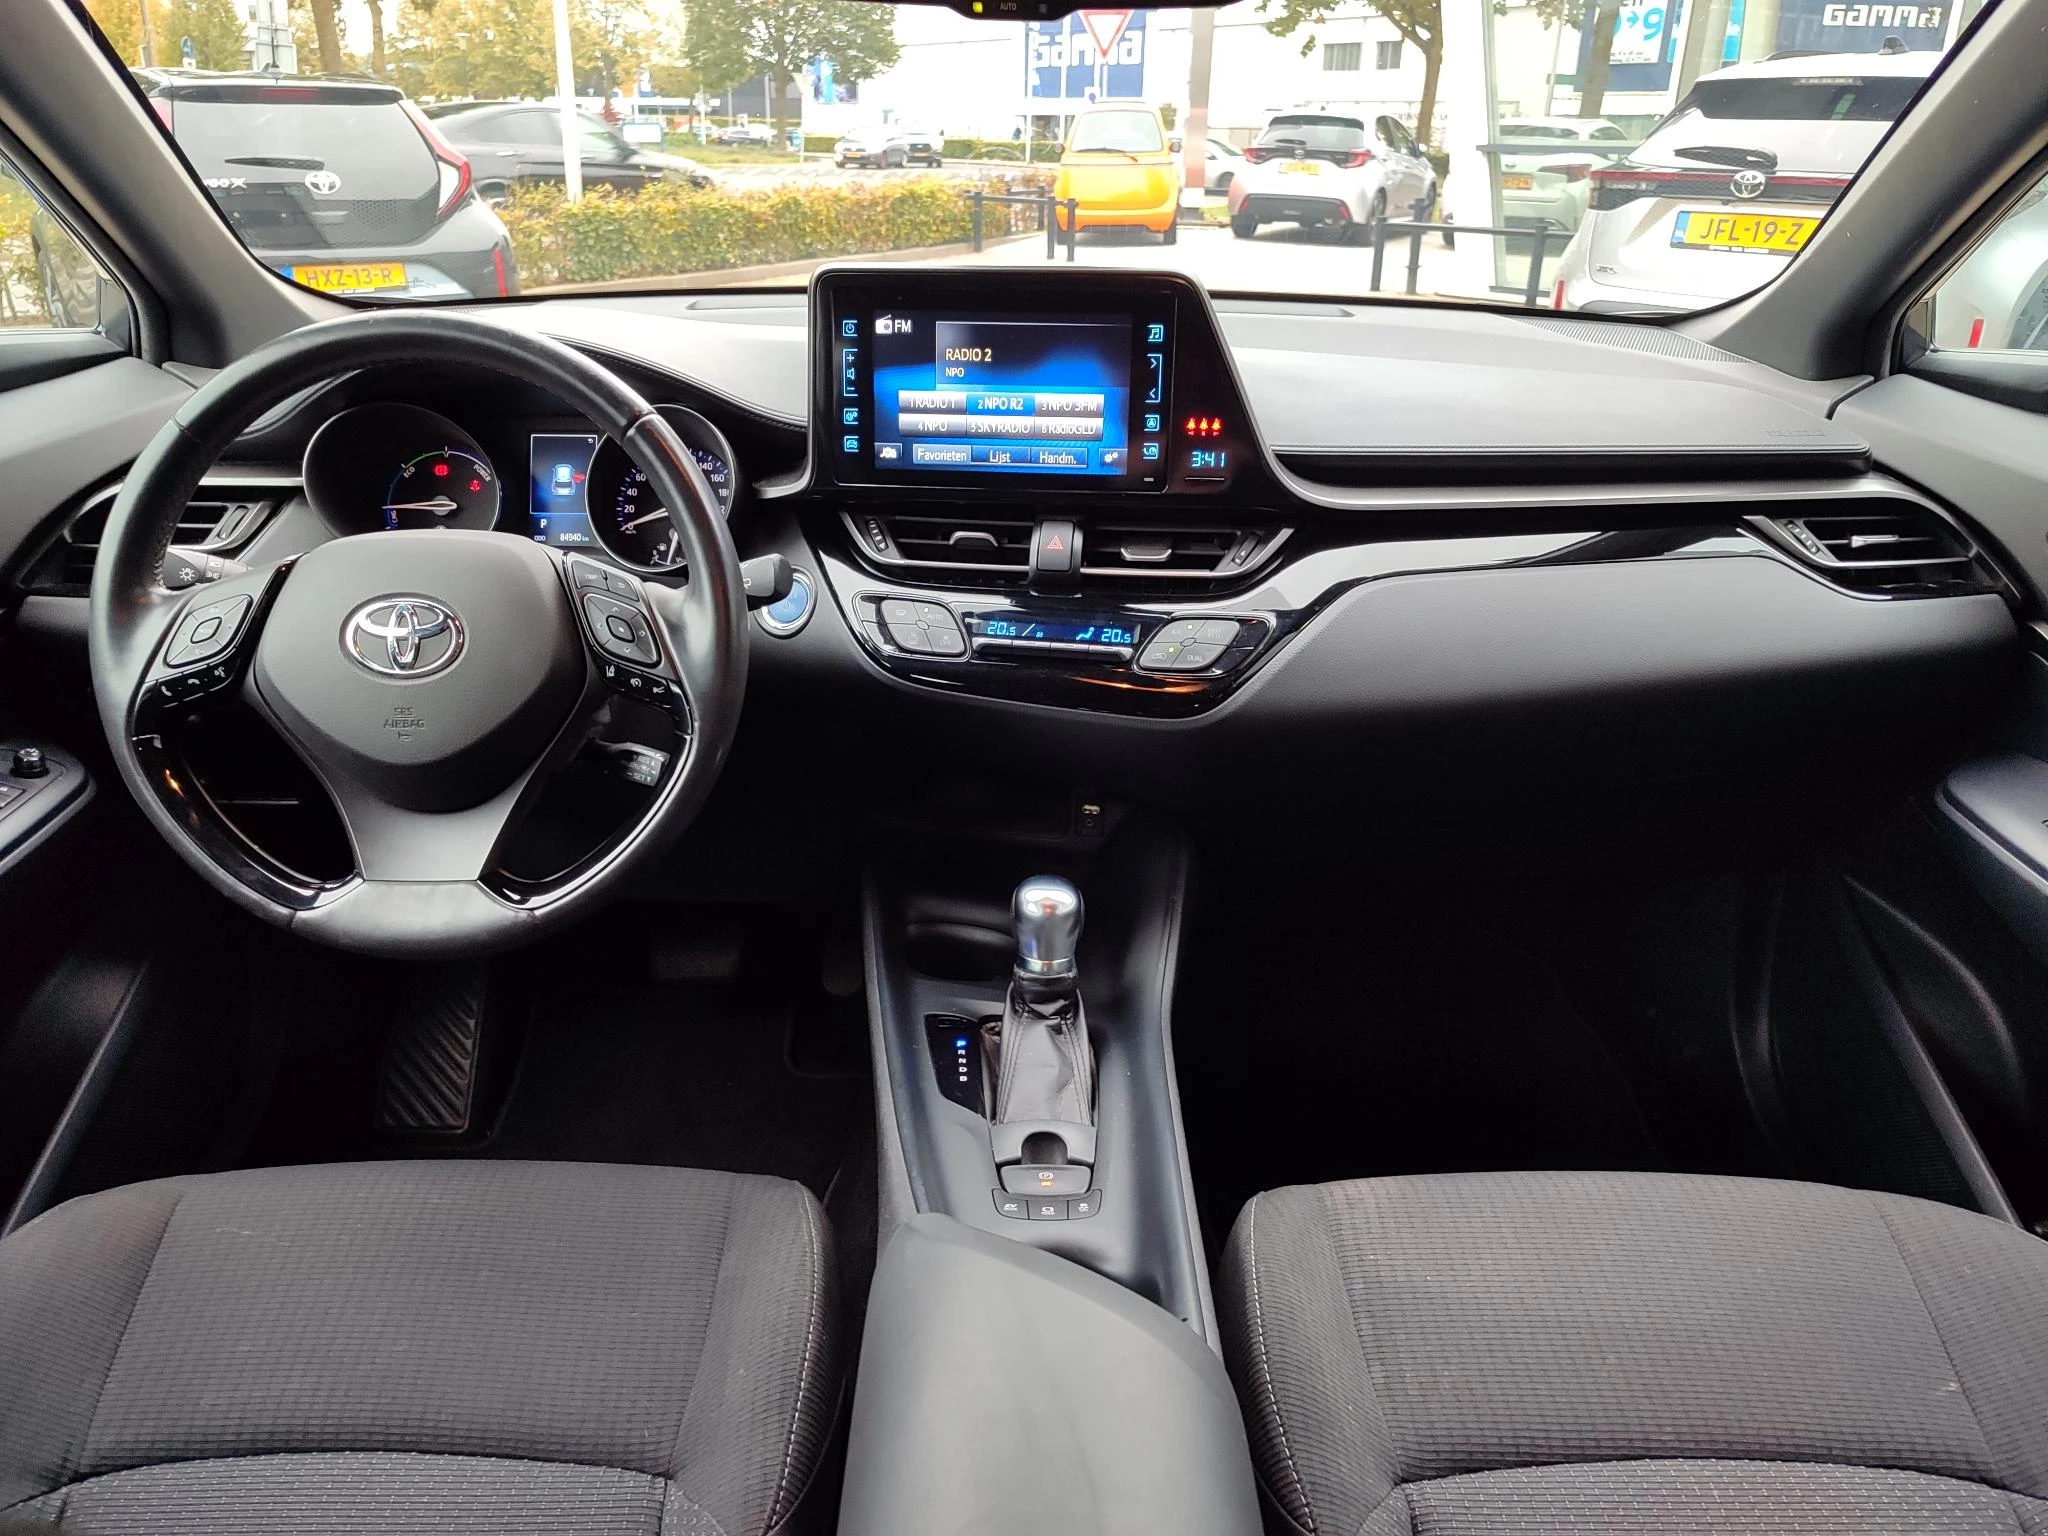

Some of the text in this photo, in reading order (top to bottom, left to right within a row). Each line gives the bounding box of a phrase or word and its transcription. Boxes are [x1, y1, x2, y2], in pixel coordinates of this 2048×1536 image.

[1000, 2, 1017, 11] AUTO
[1642, 8, 1665, 41] 9
[1700, 218, 1804, 246] JFL-19-Z
[304, 267, 393, 288] HXZ-13-R
[894, 319, 912, 333] FM
[945, 348, 992, 362] RADIO 2
[945, 367, 965, 378] NPO
[984, 396, 1008, 410] NPO
[1009, 397, 1024, 411] R2
[917, 447, 967, 462] Favorieten
[989, 449, 1011, 465] Lijst
[1039, 450, 1078, 465] Handm.
[1191, 451, 1225, 468] 3:41
[403, 466, 416, 479] ECO
[699, 462, 713, 471] 140
[635, 473, 647, 482] 60
[711, 474, 725, 482] 160
[626, 488, 638, 496] 40
[624, 505, 635, 513] 20
[540, 518, 548, 529] P
[559, 533, 582, 542] 84940
[987, 621, 1017, 637] 20.5
[1101, 628, 1132, 644] 20.5
[383, 719, 426, 729] AIRBAG
